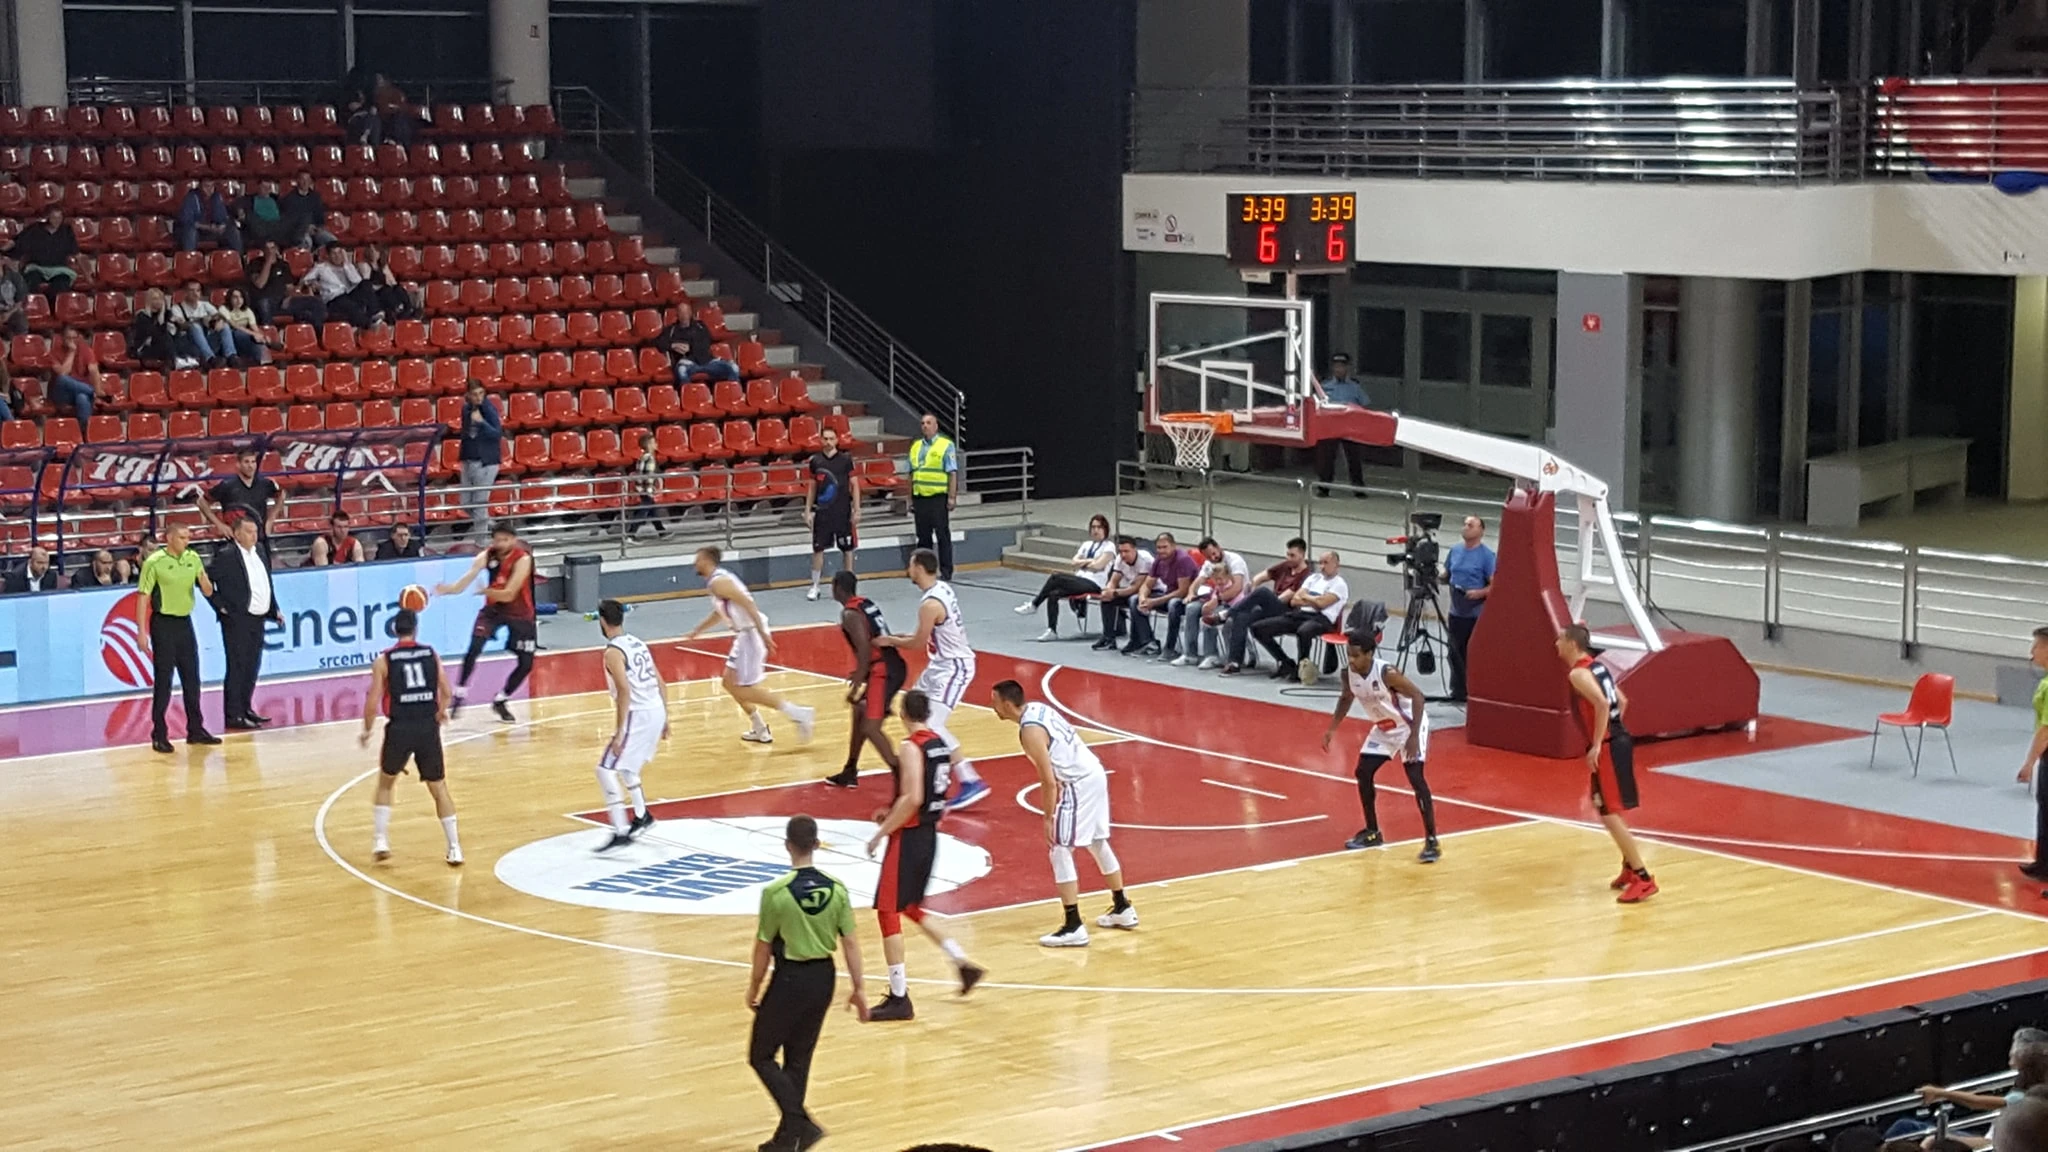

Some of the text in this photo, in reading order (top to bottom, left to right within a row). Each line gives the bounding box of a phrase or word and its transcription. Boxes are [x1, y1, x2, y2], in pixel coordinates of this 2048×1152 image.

[1242, 197, 1286, 222] 3:39
[1310, 196, 1354, 221] 3:39
[1259, 224, 1277, 263] 6
[1327, 223, 1345, 262] 6
[319, 652, 365, 669] srcem
[403, 662, 427, 689] 11
[568, 853, 747, 893] BANKA
[632, 860, 794, 901] NOVA
